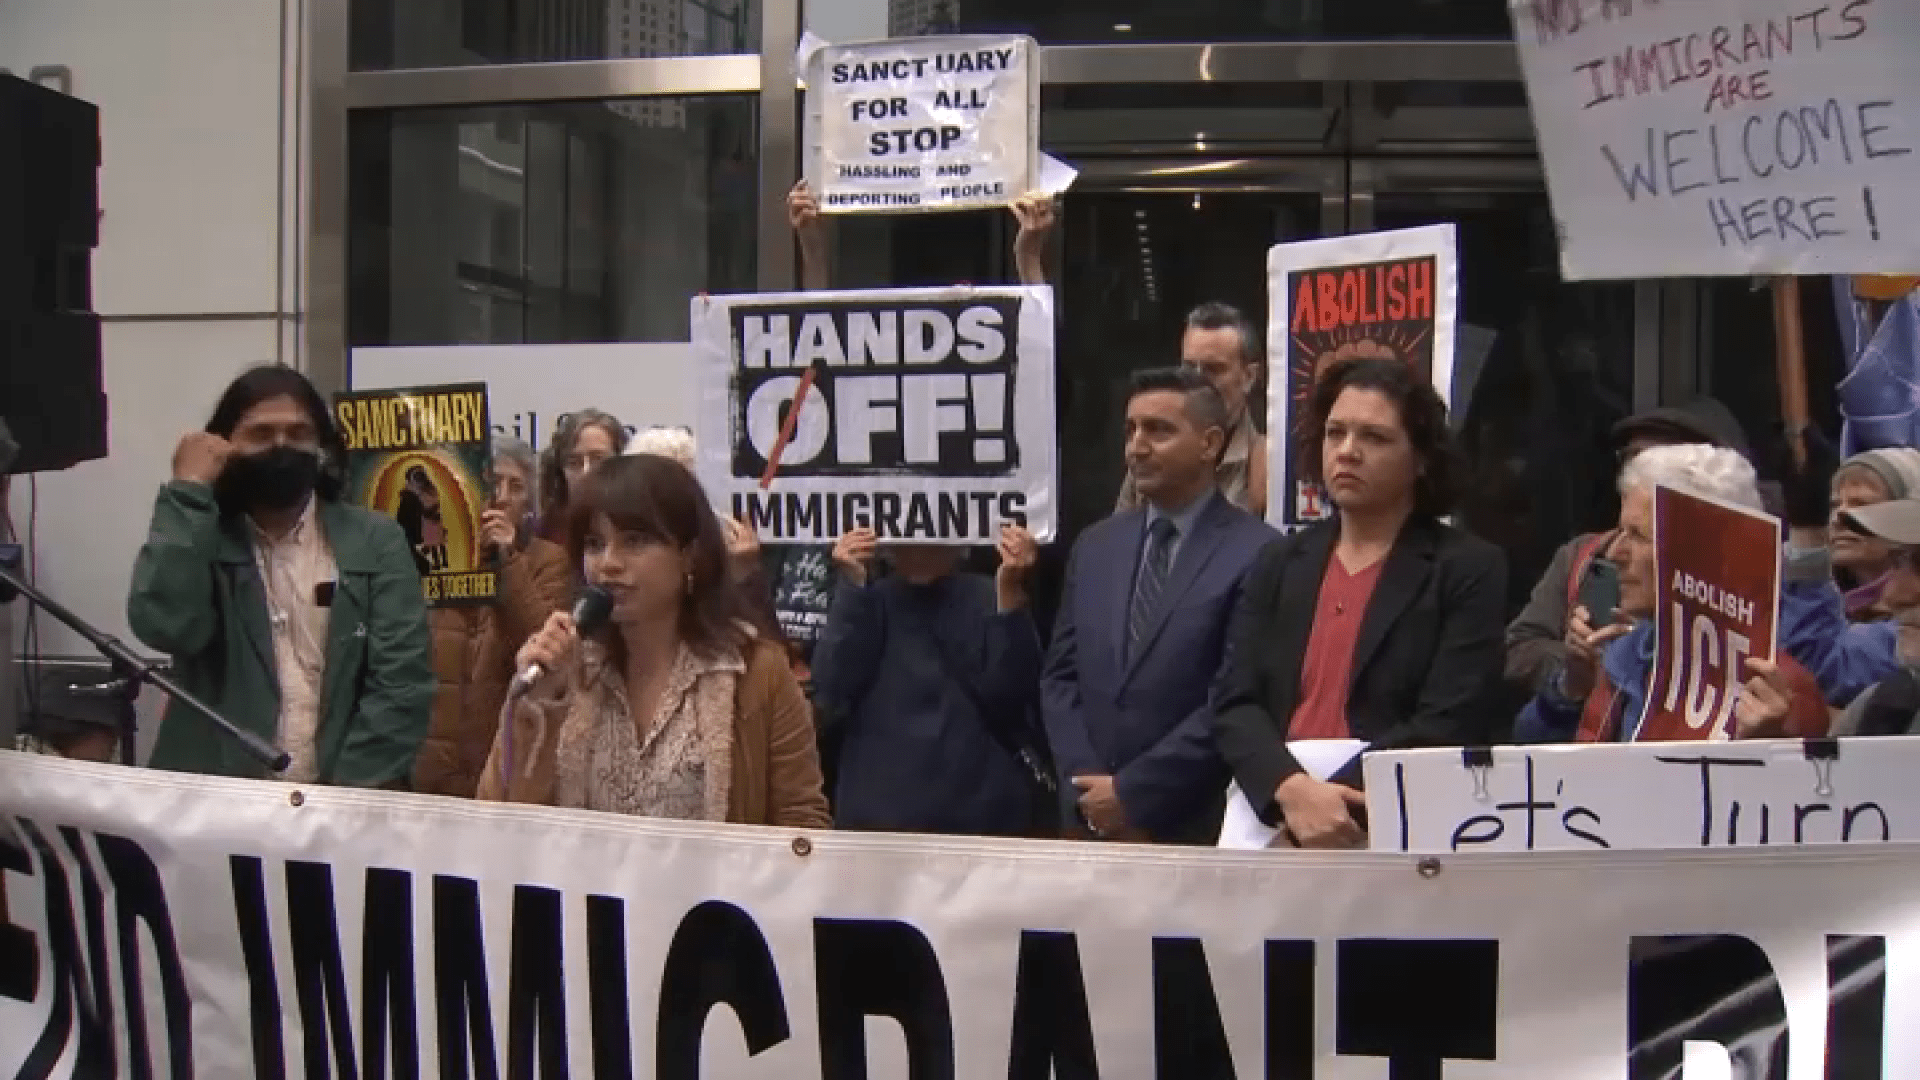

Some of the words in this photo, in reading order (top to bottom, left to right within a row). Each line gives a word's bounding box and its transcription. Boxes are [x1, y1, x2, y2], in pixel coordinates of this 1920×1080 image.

[1572, 0, 1874, 109] IMMIGRANTS
[851, 97, 908, 122] FOR
[934, 89, 988, 110] ALL
[1703, 70, 1774, 114] ARE
[838, 164, 922, 178] HASSLING
[935, 163, 973, 177] AND
[868, 125, 961, 157] STOP
[1600, 97, 1912, 202] WELCOME
[828, 193, 922, 205] DEPORTING
[940, 181, 1005, 199] PEOPLE
[1290, 260, 1431, 334] ABOLISH
[742, 304, 1007, 369] HANDS
[337, 390, 482, 450] SANCTUARY
[745, 371, 1007, 467] OFF!
[731, 491, 1028, 539] IMMIGRANTS
[1671, 568, 1755, 627] ABOLISH
[1654, 755, 1891, 847] Turn
